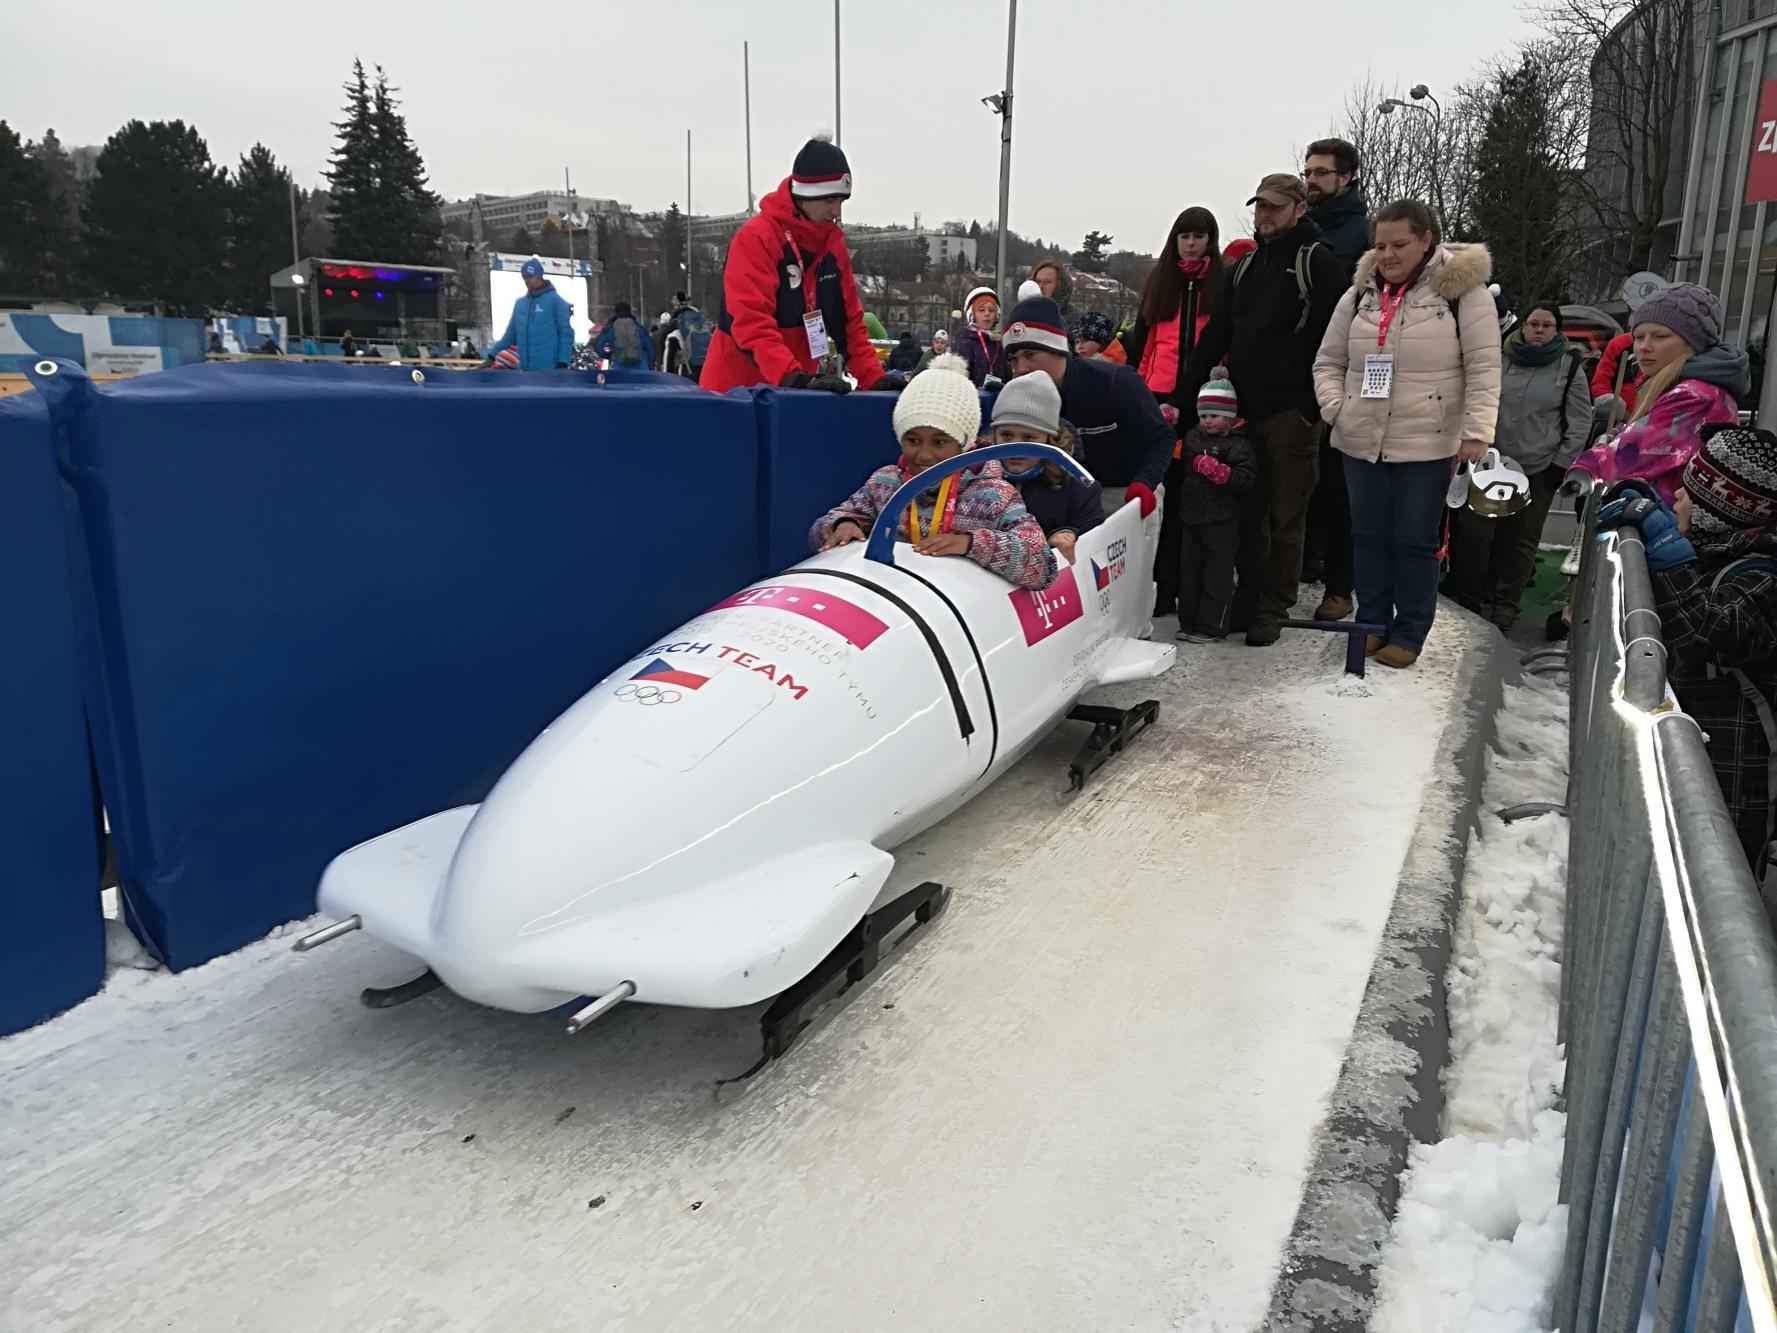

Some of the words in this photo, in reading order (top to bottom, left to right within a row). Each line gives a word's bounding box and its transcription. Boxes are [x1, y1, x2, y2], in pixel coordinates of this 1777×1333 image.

[1757, 119, 1777, 153] Z
[1107, 535, 1127, 562] CZECH
[1109, 557, 1126, 582] TEAM
[717, 645, 809, 701] TEAM
